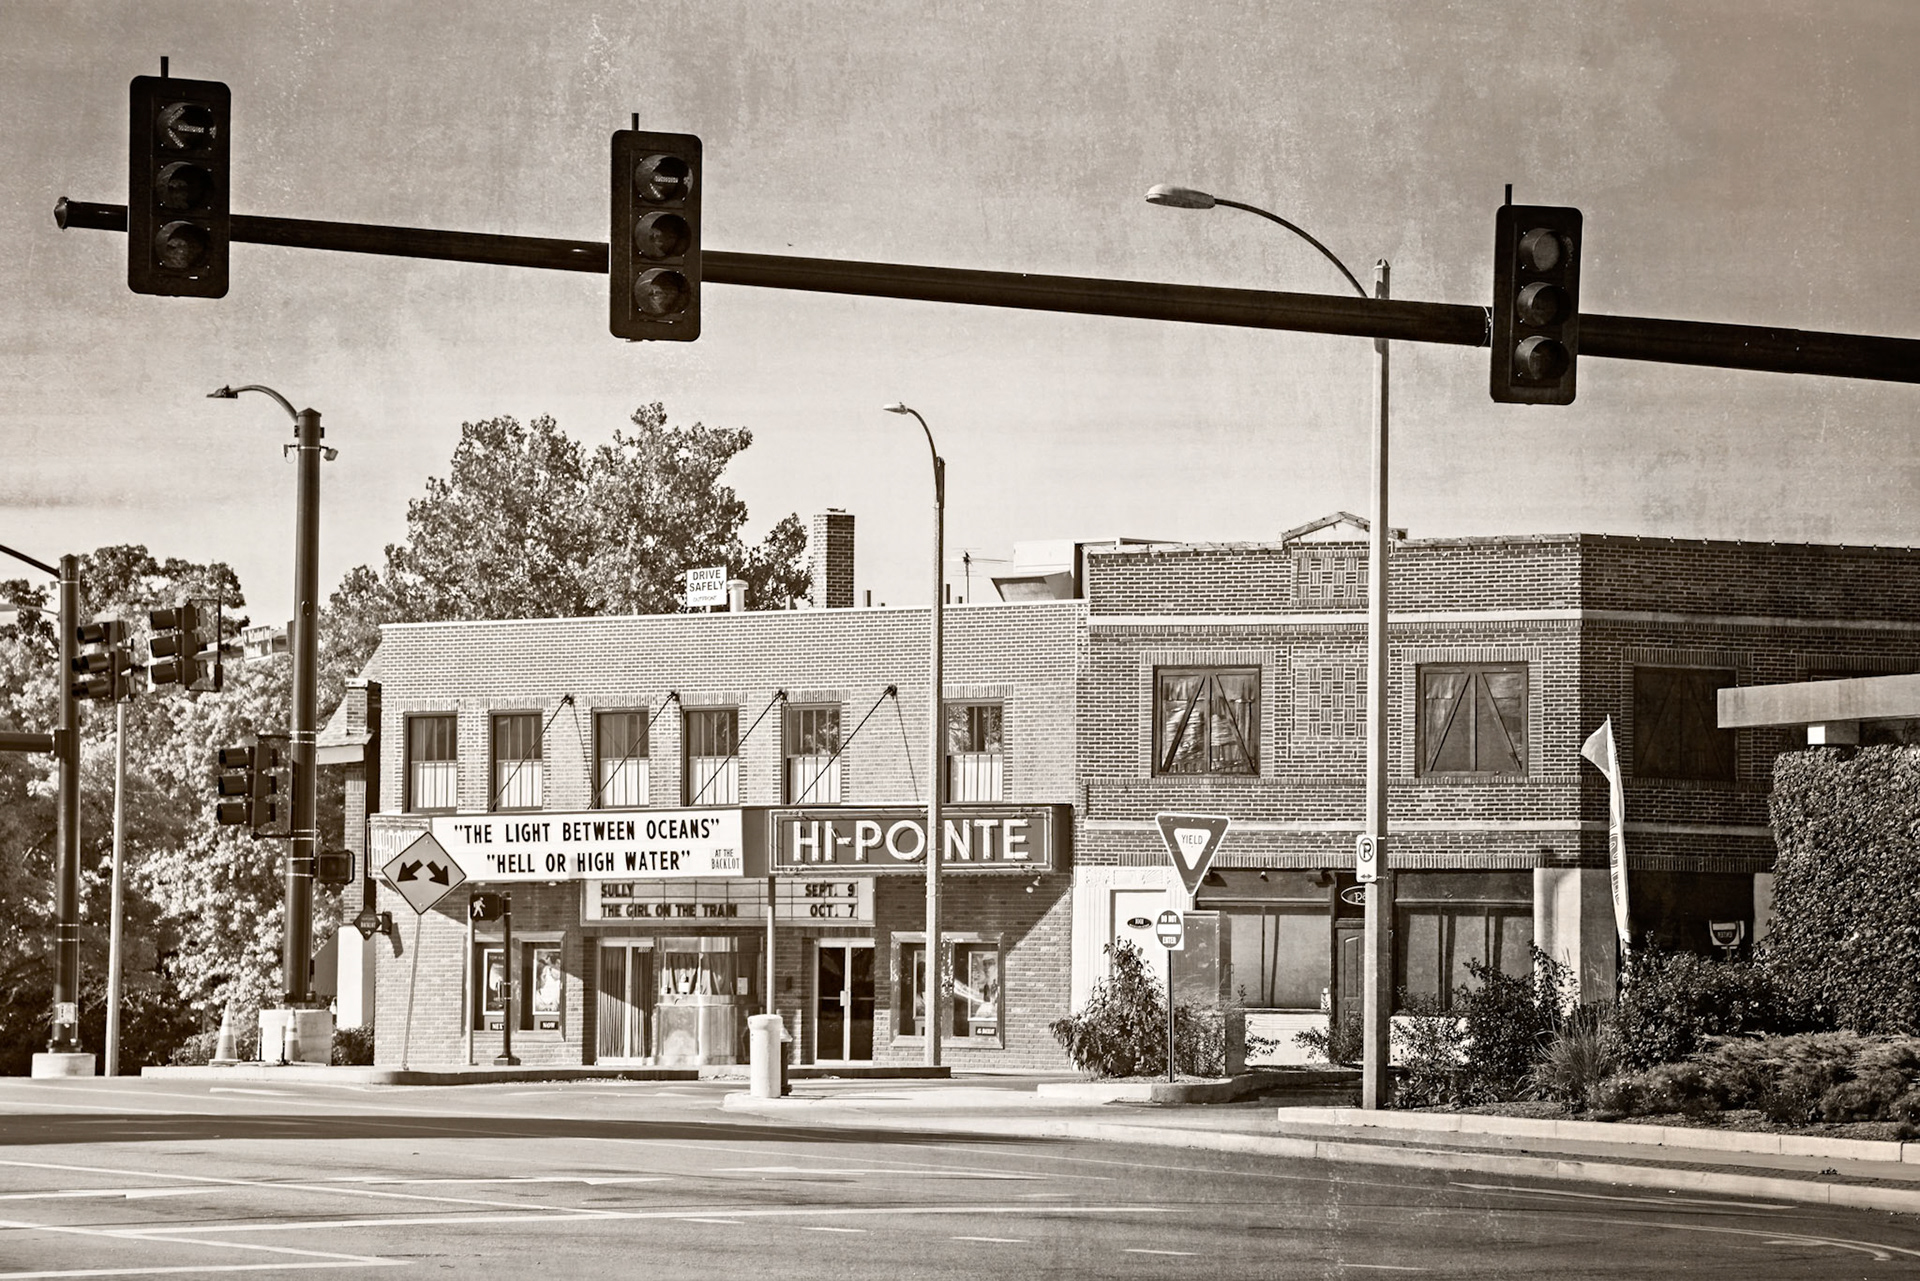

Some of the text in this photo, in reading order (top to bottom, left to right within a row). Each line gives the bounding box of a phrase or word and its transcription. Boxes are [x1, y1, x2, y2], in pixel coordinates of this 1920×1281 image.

[692, 569, 721, 581] DRIVE
[689, 580, 724, 592] SAFELY
[505, 823, 551, 843] LIGHT
[562, 820, 636, 842] BETWEEN
[793, 819, 1030, 862] HI-PONTE
[1181, 834, 1203, 845] YIELD
[714, 848, 734, 857] AT THE
[545, 853, 566, 873] OR
[577, 852, 614, 872] HIGH
[711, 857, 740, 870] BACKLOT
[601, 882, 855, 898] SULLY SEPT. 9
[601, 902, 856, 918] THE GIRL ON THE TRAIN OCT. 7
